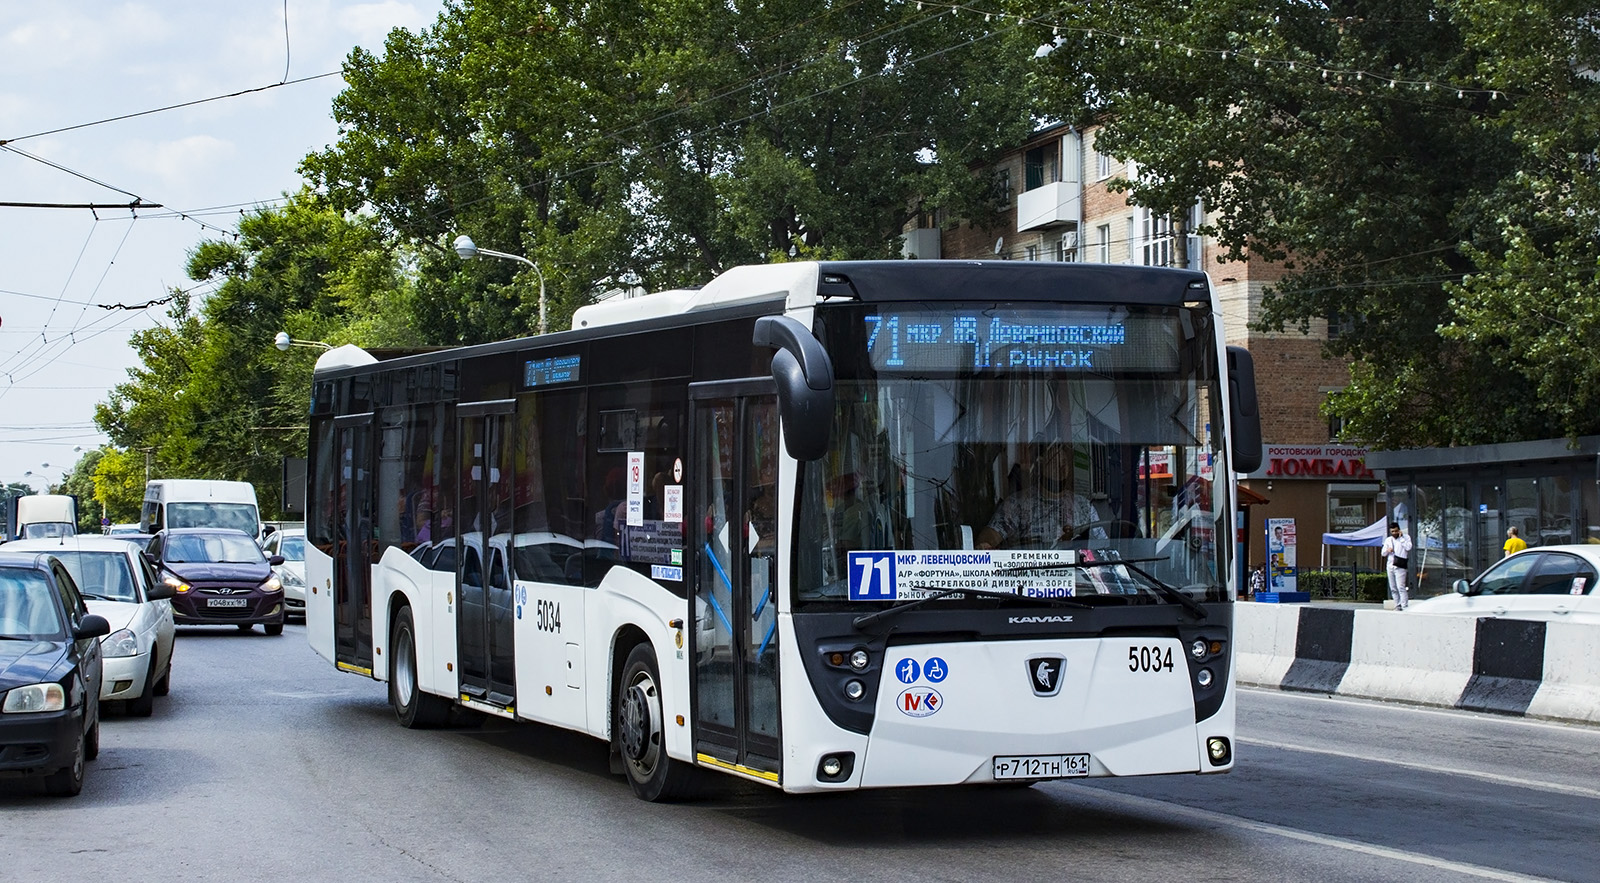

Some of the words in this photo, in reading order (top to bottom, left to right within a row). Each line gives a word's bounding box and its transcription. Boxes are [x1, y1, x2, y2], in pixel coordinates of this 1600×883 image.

[864, 316, 904, 366] 71
[1268, 447, 1322, 456] РОСТОВСКИЙ
[1325, 448, 1370, 457] ГОРОДСКО
[632, 466, 640, 482] 19
[1266, 458, 1374, 478] ЛОМБАРД
[897, 555, 919, 565] МКР.
[920, 552, 991, 566] ЛЕВЕНЦОВСКИЙ
[855, 557, 891, 595] 71
[898, 570, 913, 578] А/Р
[914, 570, 961, 578] «ФОРТУНА»,
[991, 570, 1030, 578] МИЛИЦИИ,
[1030, 570, 1040, 578] ТЦ
[908, 580, 926, 588] 339
[929, 578, 988, 588] СТРЕЛКОВОЙ
[991, 580, 1034, 589] ДИВИЗИИ
[1045, 580, 1072, 588] ЗОРГЕ
[898, 591, 926, 599] РЫНОК
[1027, 588, 1073, 598] РЫНОК
[537, 599, 561, 634] 5034
[1008, 615, 1074, 624] KAMAZ
[1128, 646, 1174, 673] 5034
[1000, 759, 1060, 776] Р712ТН
[1063, 756, 1085, 769] 161
